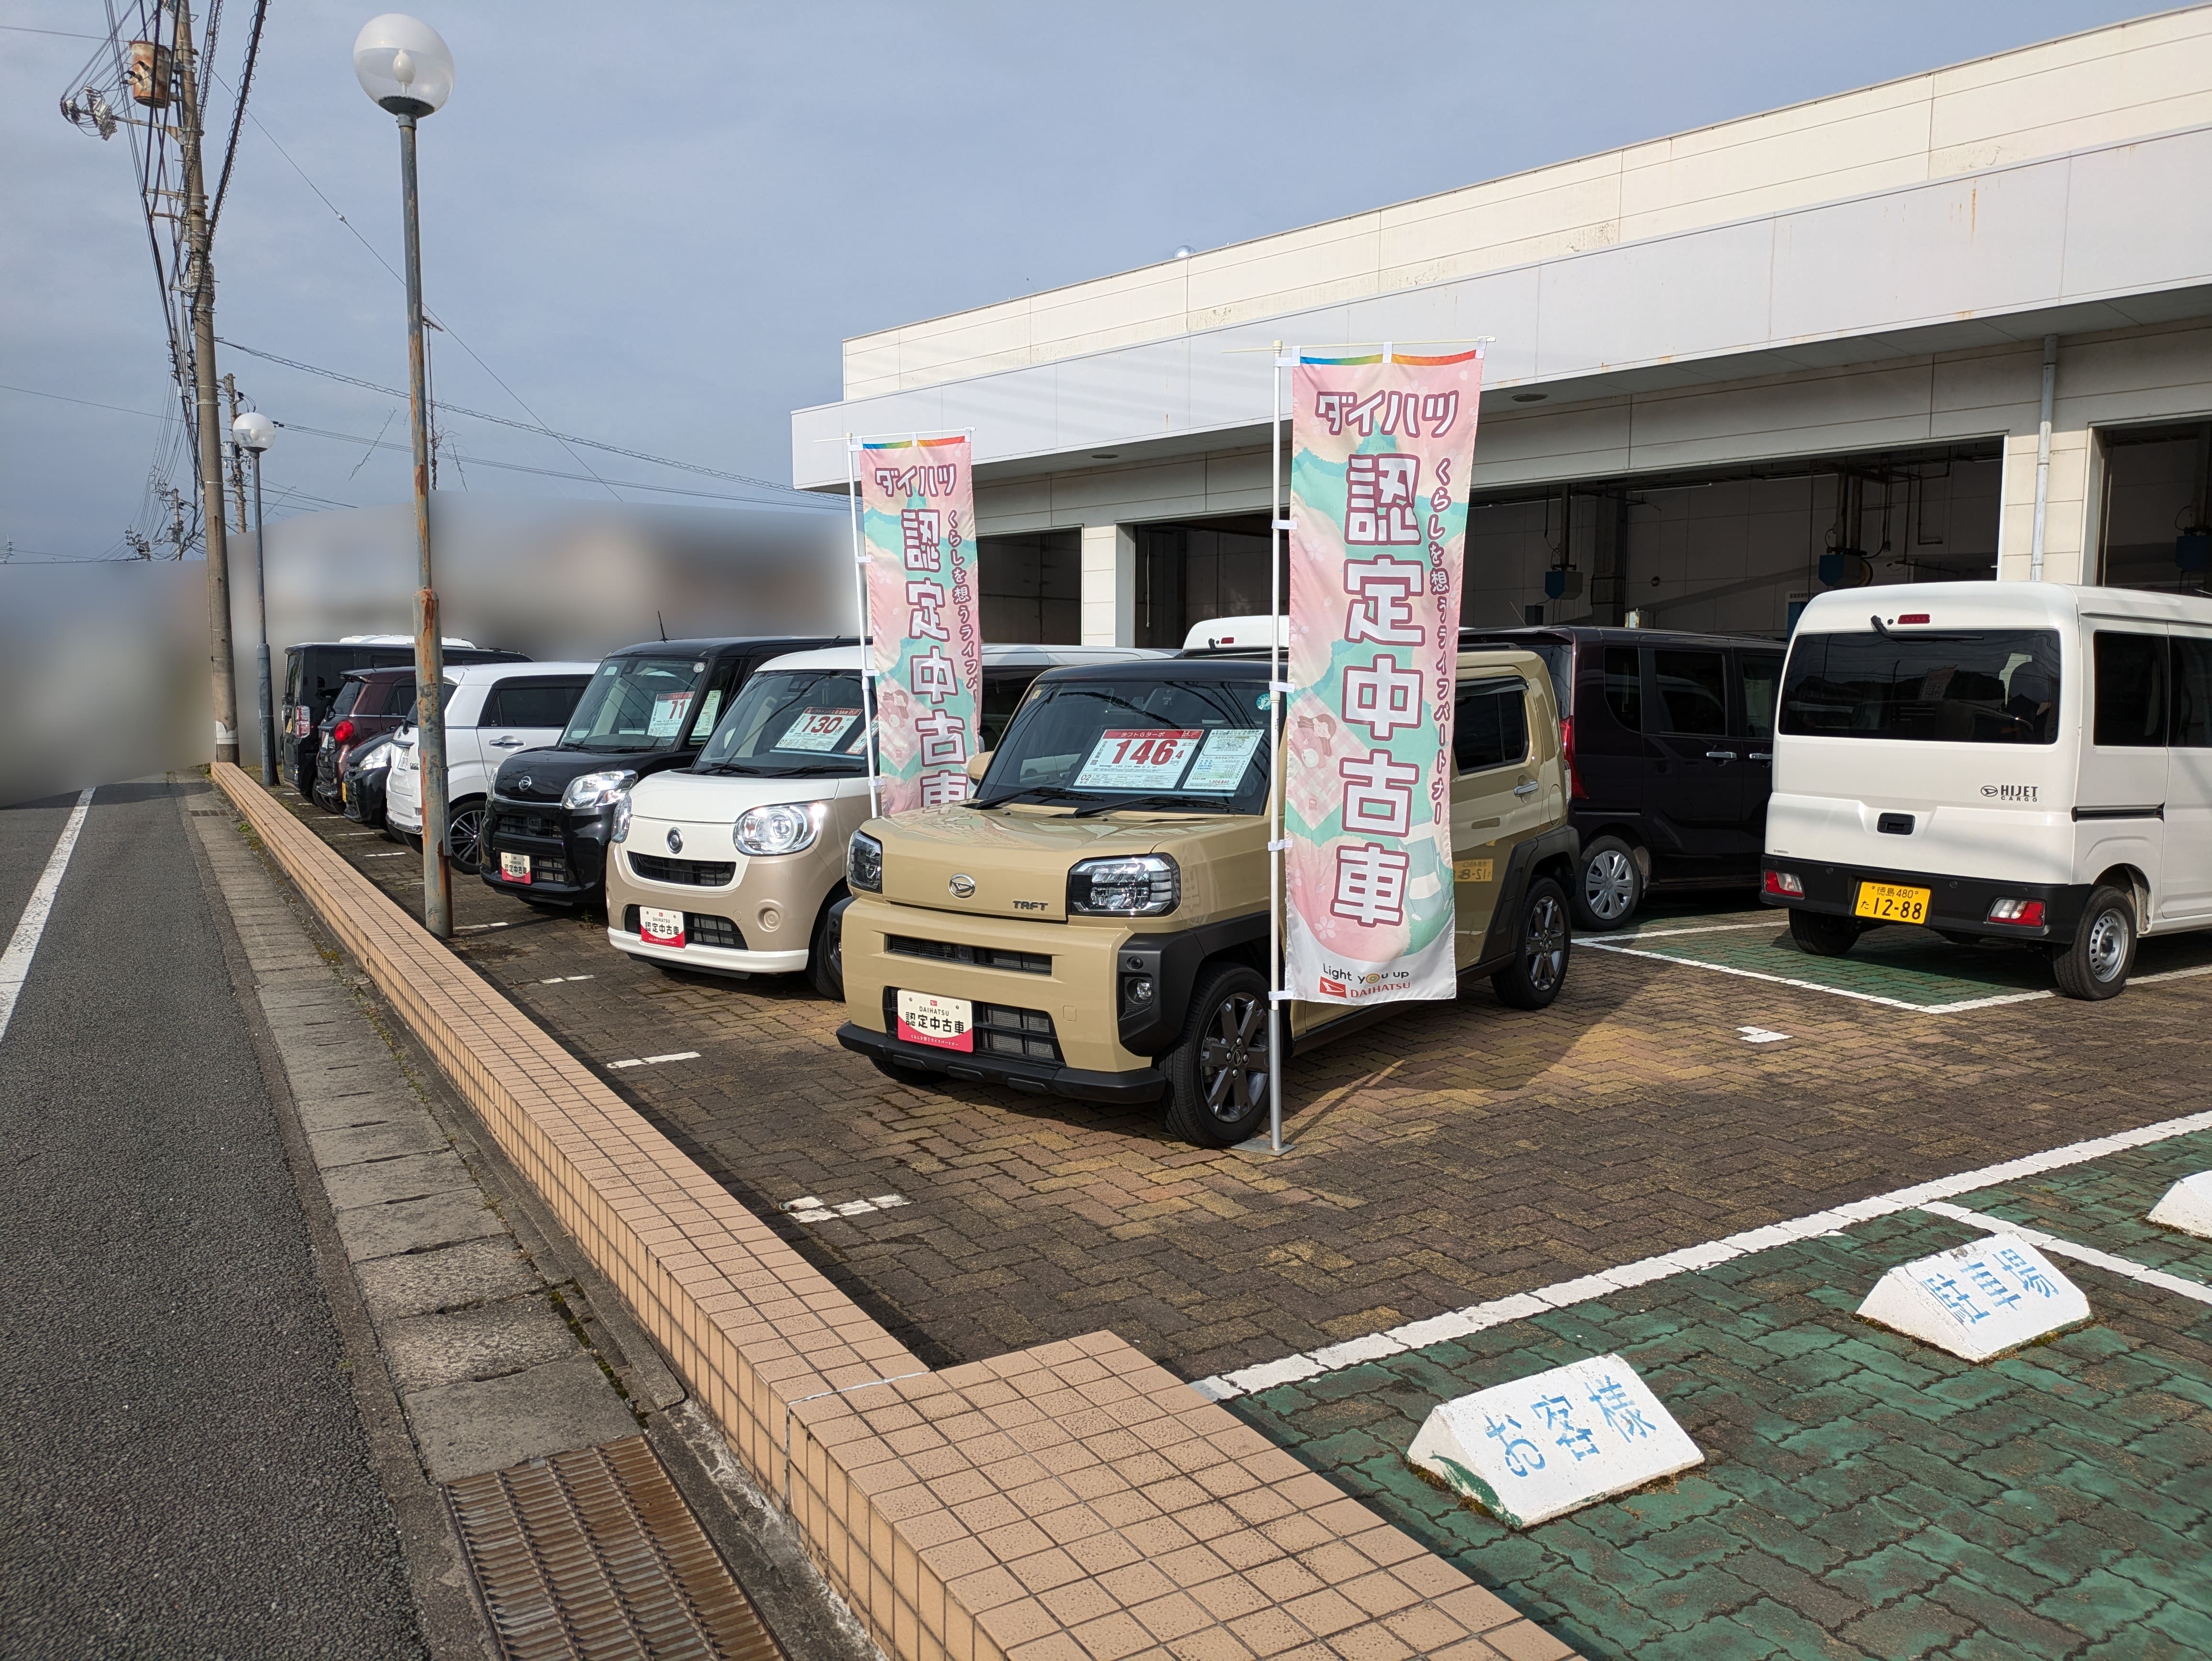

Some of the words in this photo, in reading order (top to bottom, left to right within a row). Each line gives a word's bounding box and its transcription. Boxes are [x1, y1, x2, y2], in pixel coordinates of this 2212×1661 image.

[1315, 390, 1459, 438] ダイハツ
[875, 463, 957, 498] ダイハツ
[1431, 457, 1451, 825] くらしを想うライフパートナー
[901, 509, 969, 805] 認定中古車
[1330, 454, 1426, 928] 認定中古車
[2001, 785, 2038, 797] HIJET
[1896, 889, 1913, 898] 480
[1013, 900, 1049, 911] TAFT
[1873, 897, 1922, 920] 12-88
[645, 921, 679, 935] 認定中古車
[1323, 963, 1352, 981] Light
[1393, 971, 1409, 979] up
[1350, 982, 1411, 998] DAIHATSU
[919, 1006, 949, 1016] DAIHATSU
[906, 1012, 964, 1034] 認定中古車
[1486, 1374, 1656, 1477] お客様
